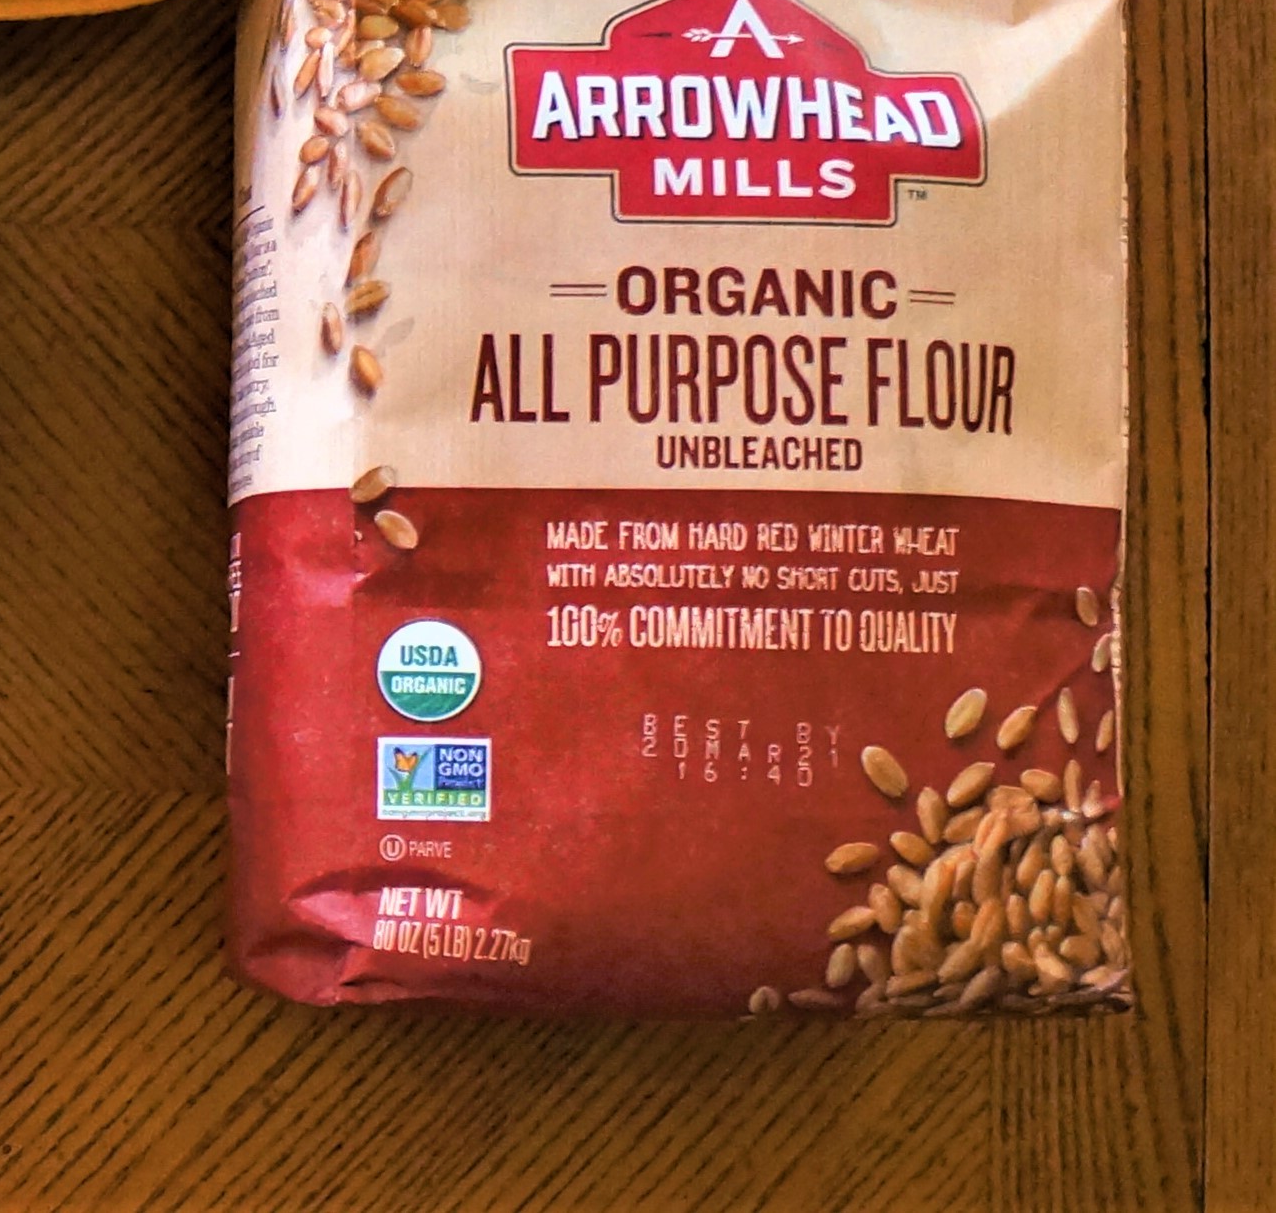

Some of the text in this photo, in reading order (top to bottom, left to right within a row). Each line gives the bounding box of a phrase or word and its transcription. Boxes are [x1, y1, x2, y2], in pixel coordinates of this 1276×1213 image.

[531, 70, 962, 149] ARROWHEAD
[653, 156, 857, 200] MILLS
[615, 265, 899, 320] ORGANIC
[469, 333, 1016, 436] ALL PURPOSE FLOUR
[655, 435, 863, 471] UNBLEACHED
[546, 521, 960, 556] MADE FROM HARD RED WINTER WHEAT
[546, 563, 959, 596] WITH ABSOLUTELY NO SHORT JUST
[546, 605, 958, 654] 100% COMMITMENT TO QUALITY
[401, 645, 459, 667] USDA
[391, 676, 466, 695] ORGANIC
[438, 762, 484, 777] GMO
[439, 748, 484, 762] NON
[409, 840, 452, 859] PARVE
[378, 887, 463, 920] NET WT
